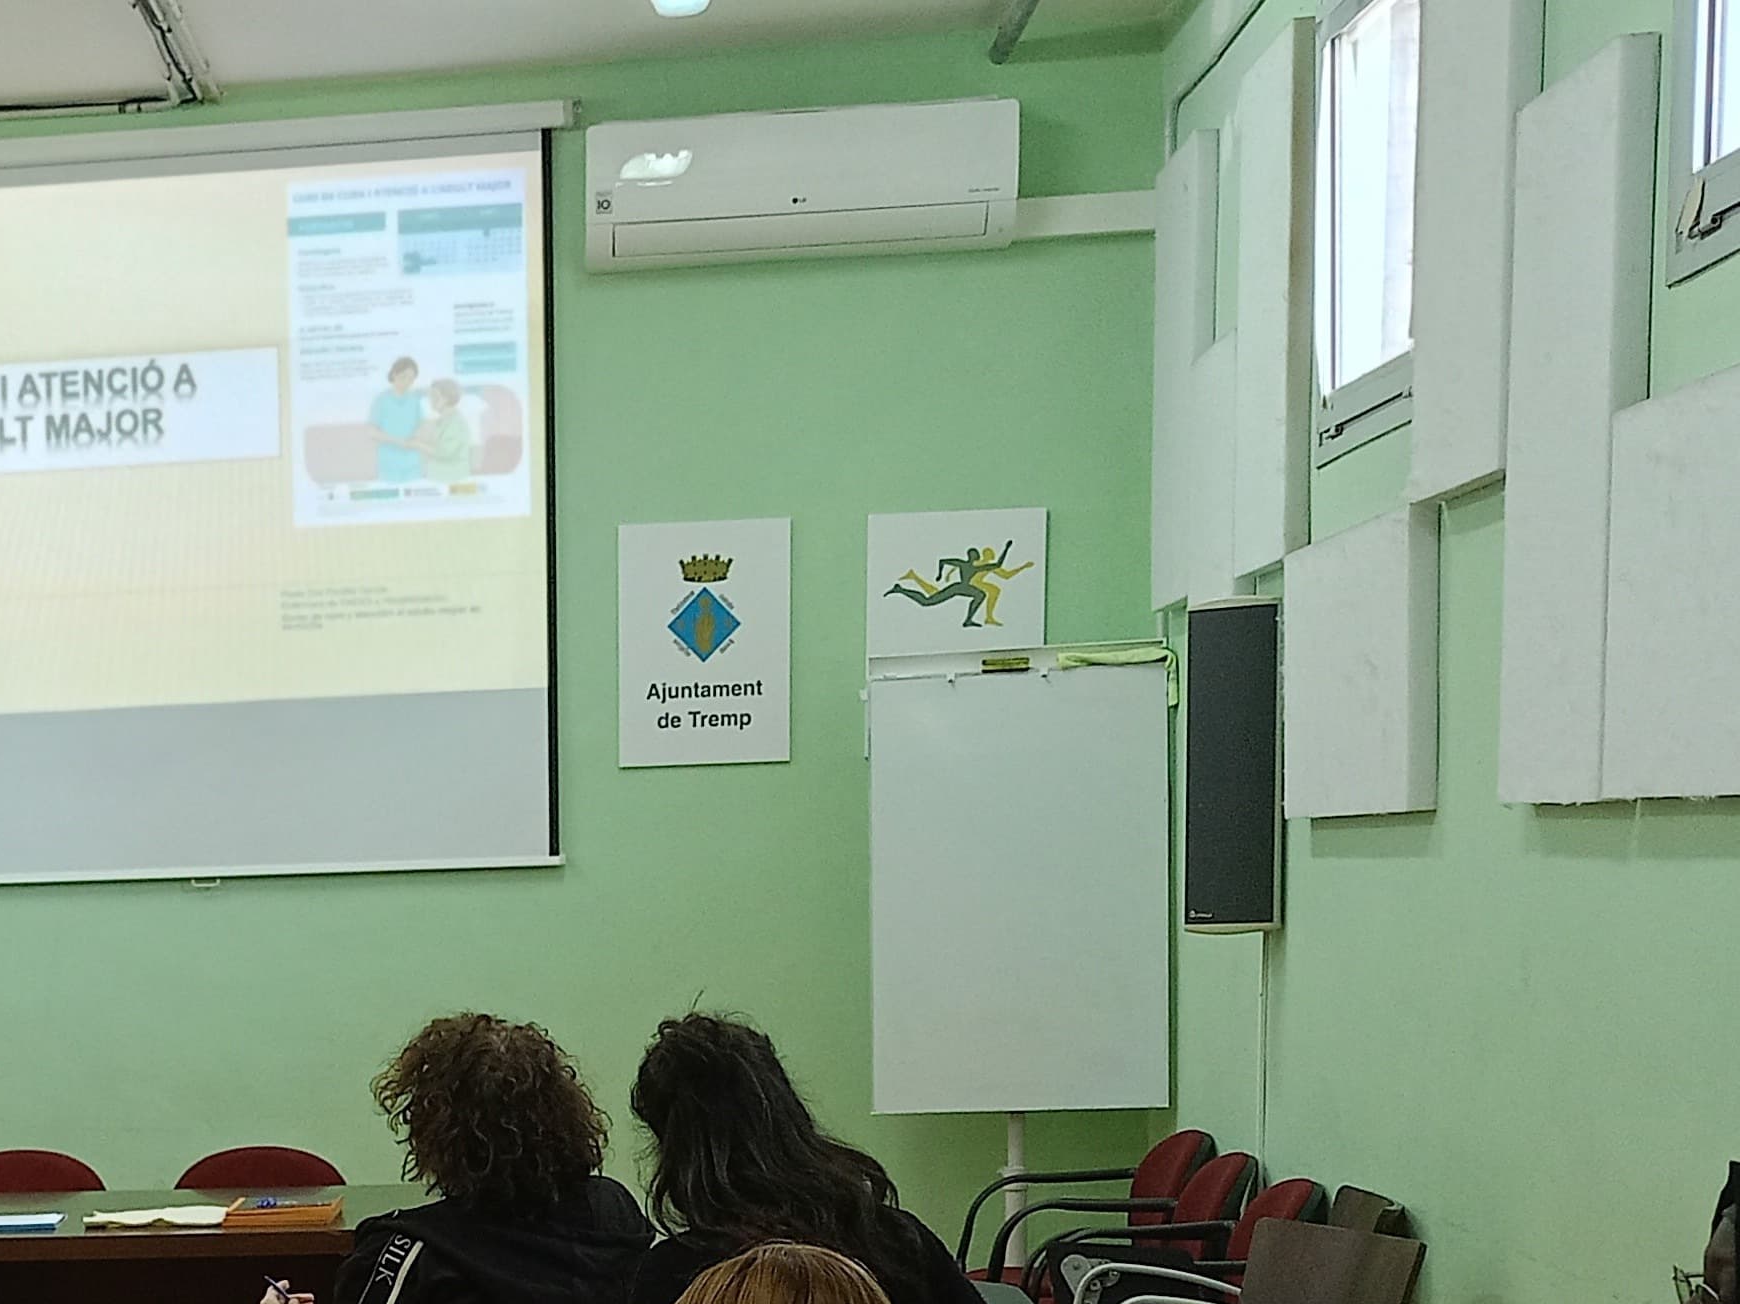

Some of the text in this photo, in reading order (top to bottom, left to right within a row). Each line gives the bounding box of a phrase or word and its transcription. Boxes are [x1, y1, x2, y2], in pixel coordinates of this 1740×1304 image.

[0, 374, 8, 402] I
[17, 359, 165, 401] ATENCIÓ
[175, 363, 197, 391] A
[45, 407, 165, 443] MAJOR
[646, 680, 764, 704] Ajuntament
[657, 711, 752, 731] de Tremp
[375, 1234, 411, 1286] SILK
